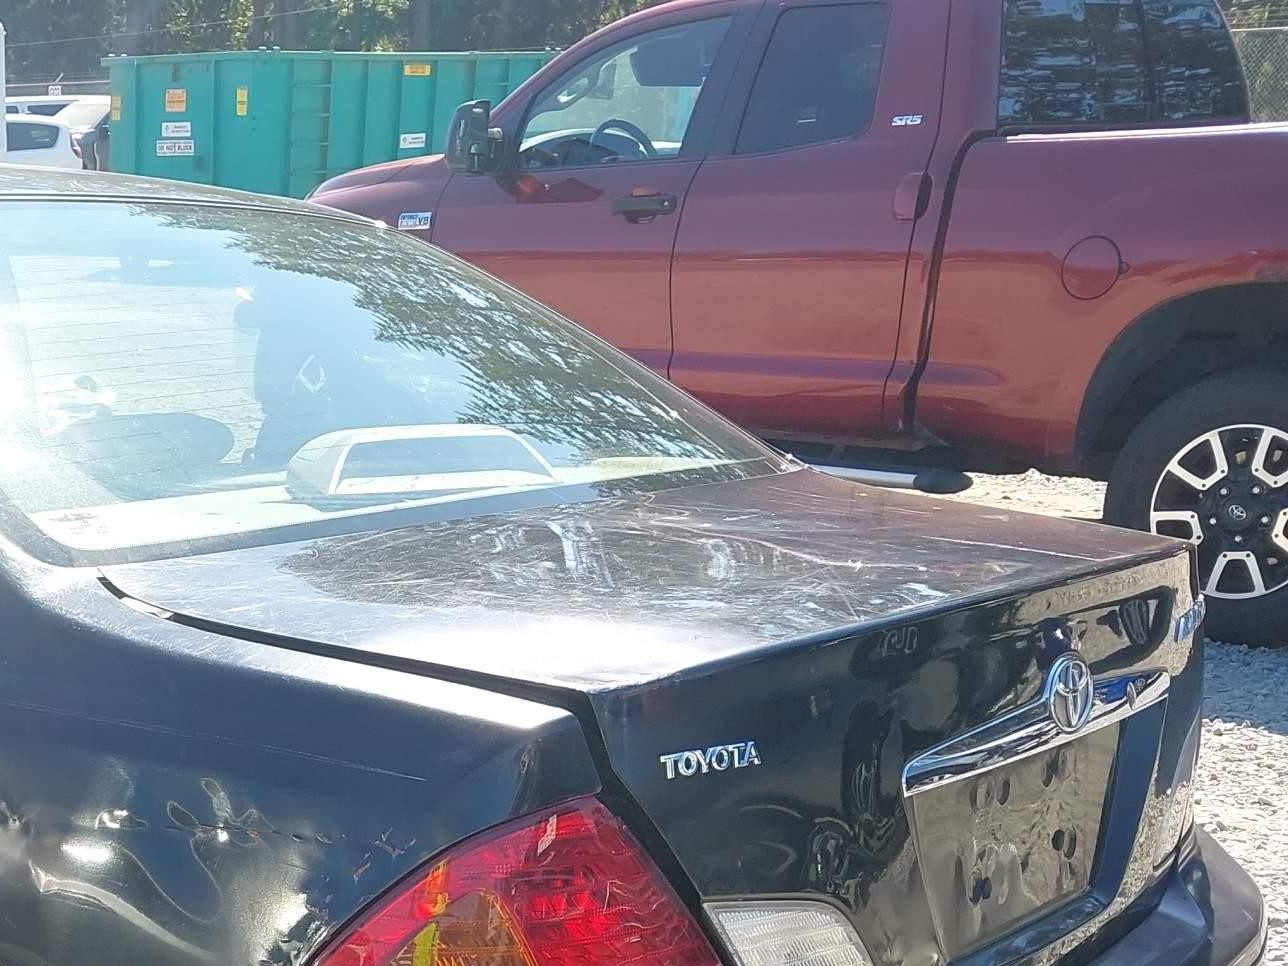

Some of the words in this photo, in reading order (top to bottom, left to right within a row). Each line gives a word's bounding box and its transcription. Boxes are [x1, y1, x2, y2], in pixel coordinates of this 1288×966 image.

[891, 114, 923, 126] SR5
[418, 215, 430, 225] V8
[660, 741, 762, 779] TOYOTA
